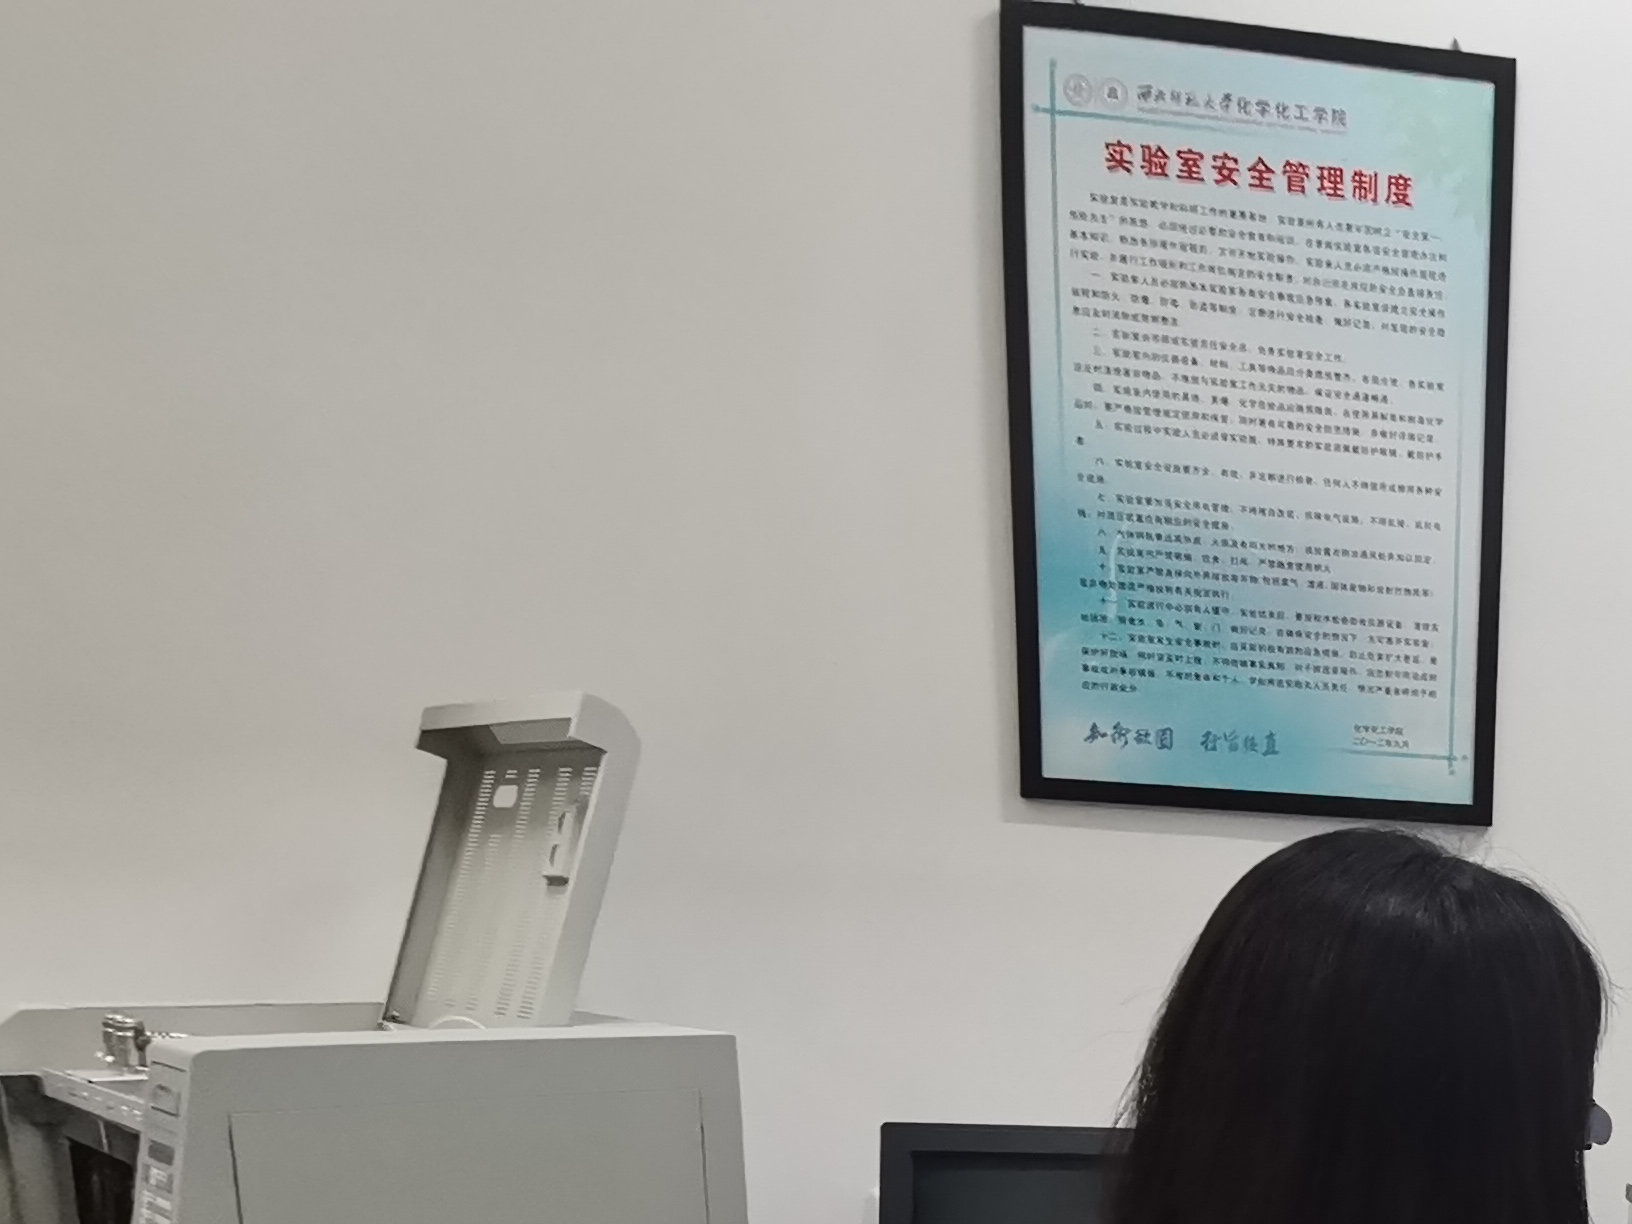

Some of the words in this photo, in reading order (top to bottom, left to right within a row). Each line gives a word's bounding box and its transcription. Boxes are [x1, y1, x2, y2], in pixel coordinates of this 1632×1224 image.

[1104, 139, 1412, 207] 实验室安全管理制度
